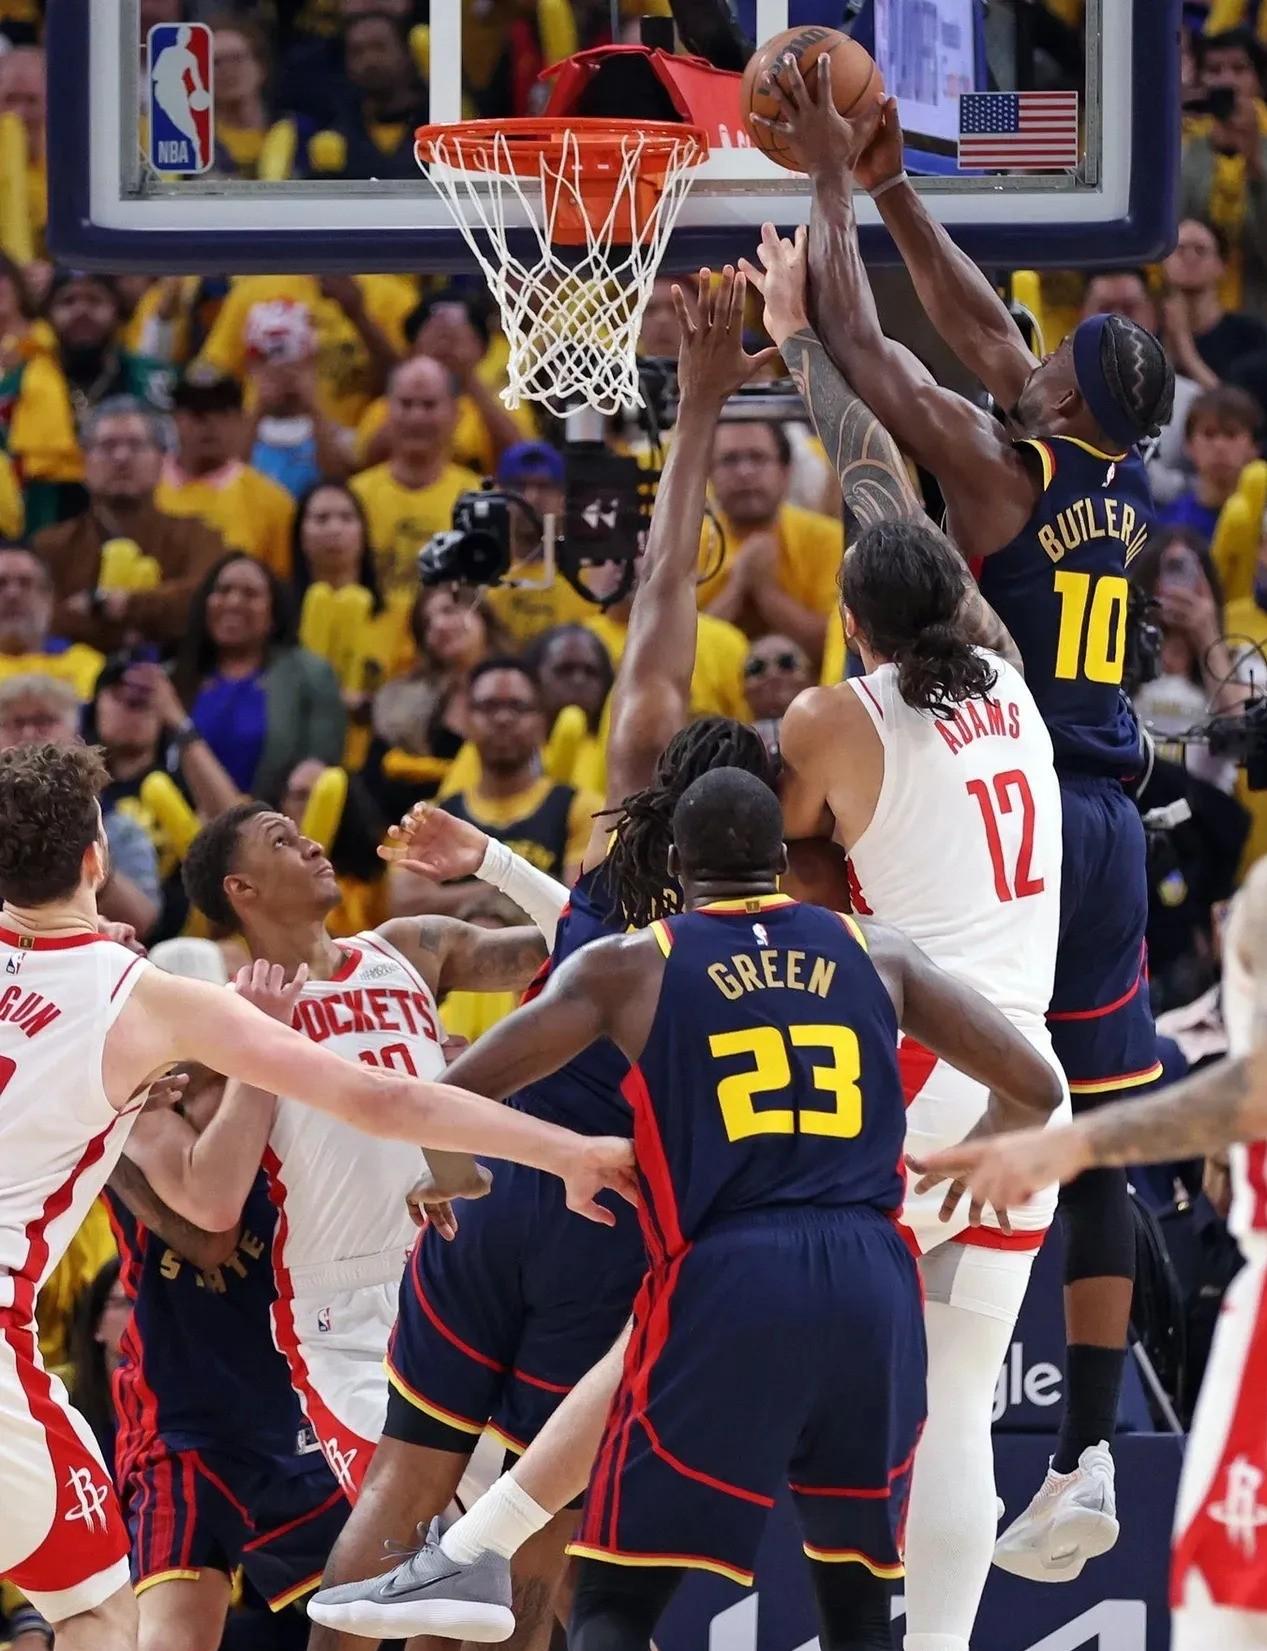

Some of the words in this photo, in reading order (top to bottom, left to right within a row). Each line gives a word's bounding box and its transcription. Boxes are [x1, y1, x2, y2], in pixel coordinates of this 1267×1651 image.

[158, 140, 189, 164] NBA
[1038, 498, 1136, 563] BUTLER
[1053, 570, 1129, 685] 10
[934, 698, 1020, 755] ADAMS
[966, 769, 1045, 903] 12
[707, 950, 837, 1000] GREEN
[291, 988, 438, 1043] OCKETS
[708, 1023, 862, 1143] 23
[160, 1229, 265, 1294] SATE
